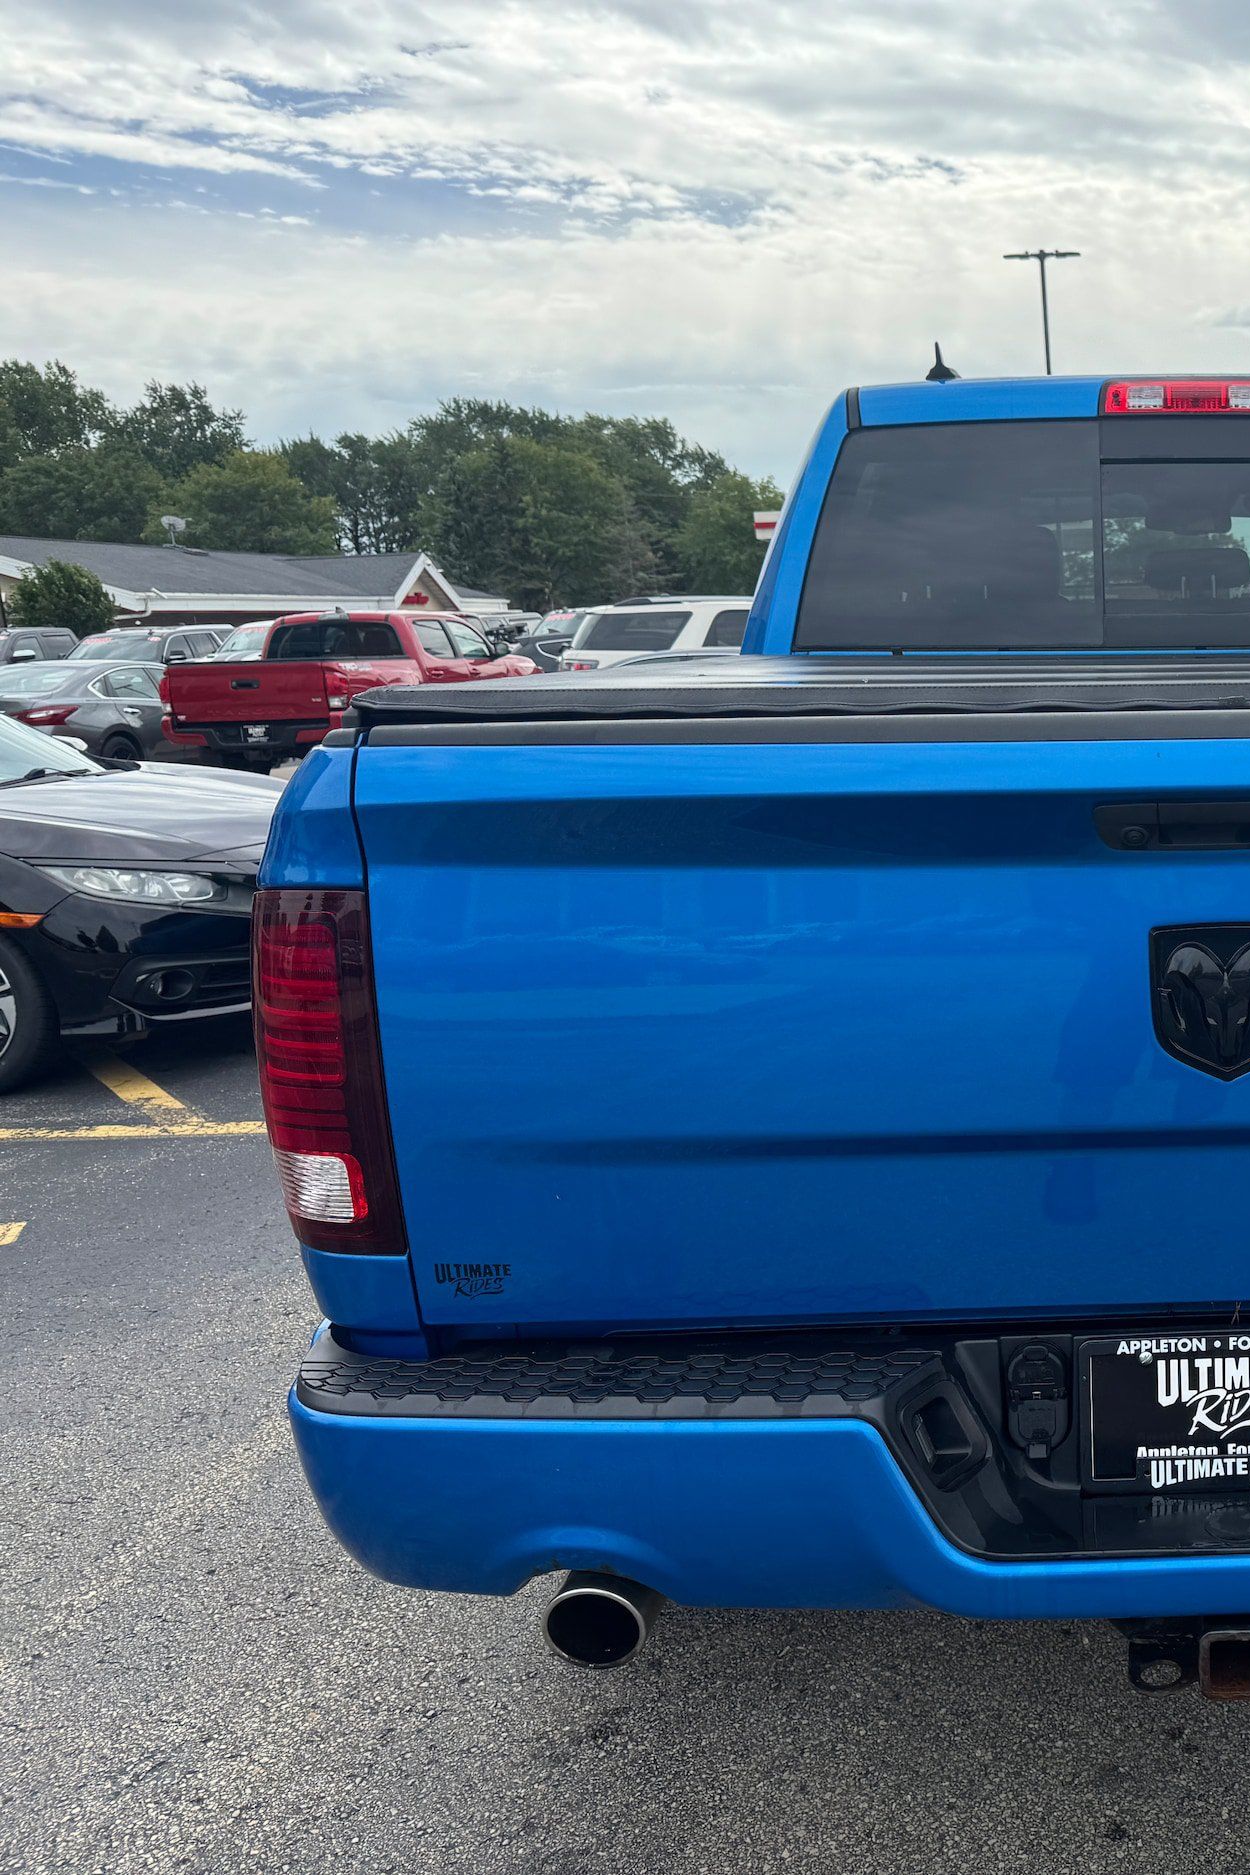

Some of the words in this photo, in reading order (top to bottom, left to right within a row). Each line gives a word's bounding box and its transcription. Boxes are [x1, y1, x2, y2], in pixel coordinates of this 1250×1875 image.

[434, 1263, 512, 1284] ULTIMATE
[1117, 1337, 1207, 1355] APPLETON
[1150, 1457, 1249, 1489] ULTIMATE
